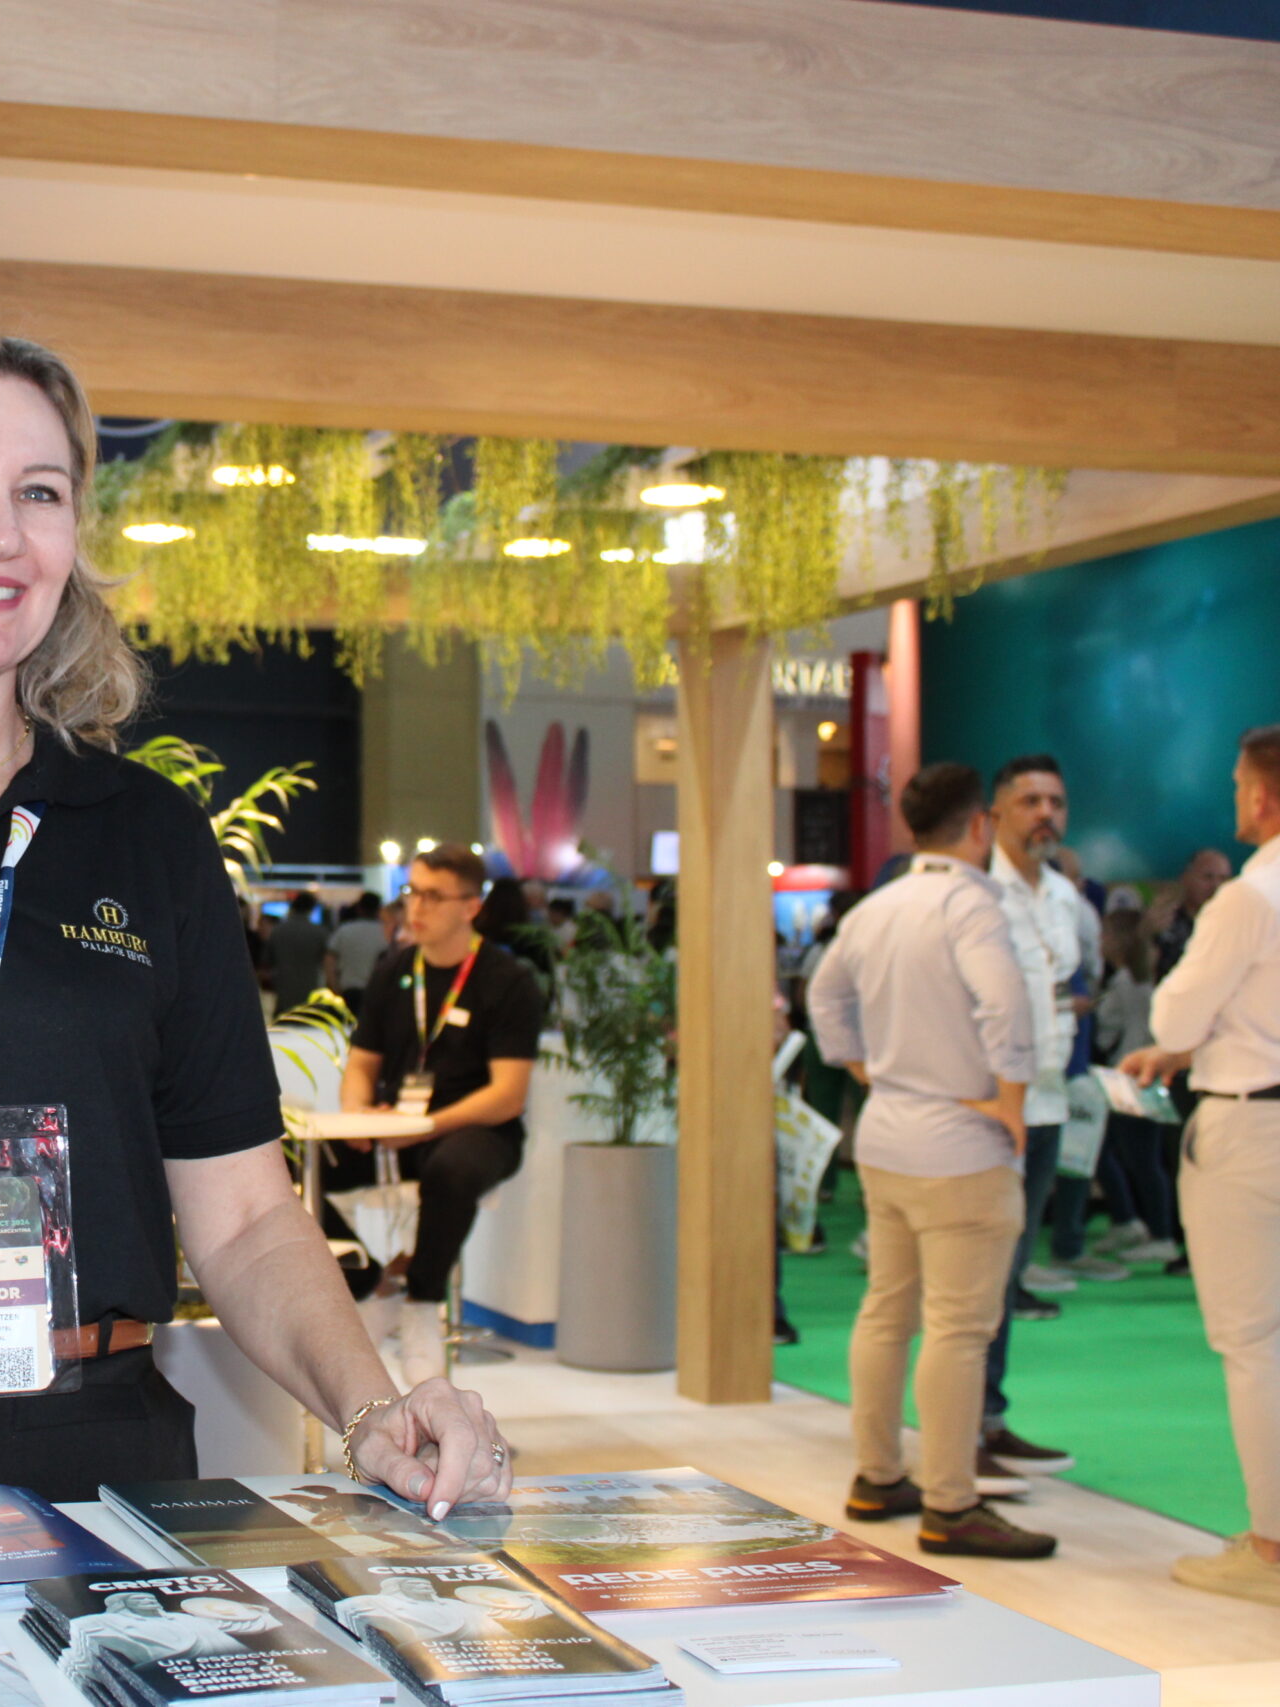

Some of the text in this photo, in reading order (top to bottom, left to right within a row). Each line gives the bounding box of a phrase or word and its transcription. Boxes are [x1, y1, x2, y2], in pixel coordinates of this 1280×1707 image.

[101, 905, 121, 925] H
[80, 941, 125, 957] PALACE
[368, 1564, 497, 1575] CRISTO
[437, 1571, 510, 1582] LUZ
[558, 1560, 843, 1585] REDE PIRES
[88, 1575, 219, 1591] CRISTO
[158, 1583, 234, 1595] LUZ
[422, 1637, 593, 1648] Un espectáculo
[428, 1646, 458, 1654] de
[461, 1644, 521, 1653] luces
[157, 1647, 328, 1668] Un espectáculo
[435, 1651, 517, 1660] colores
[166, 1664, 195, 1674] de
[198, 1659, 259, 1671] luces
[174, 1663, 288, 1680] colores en
